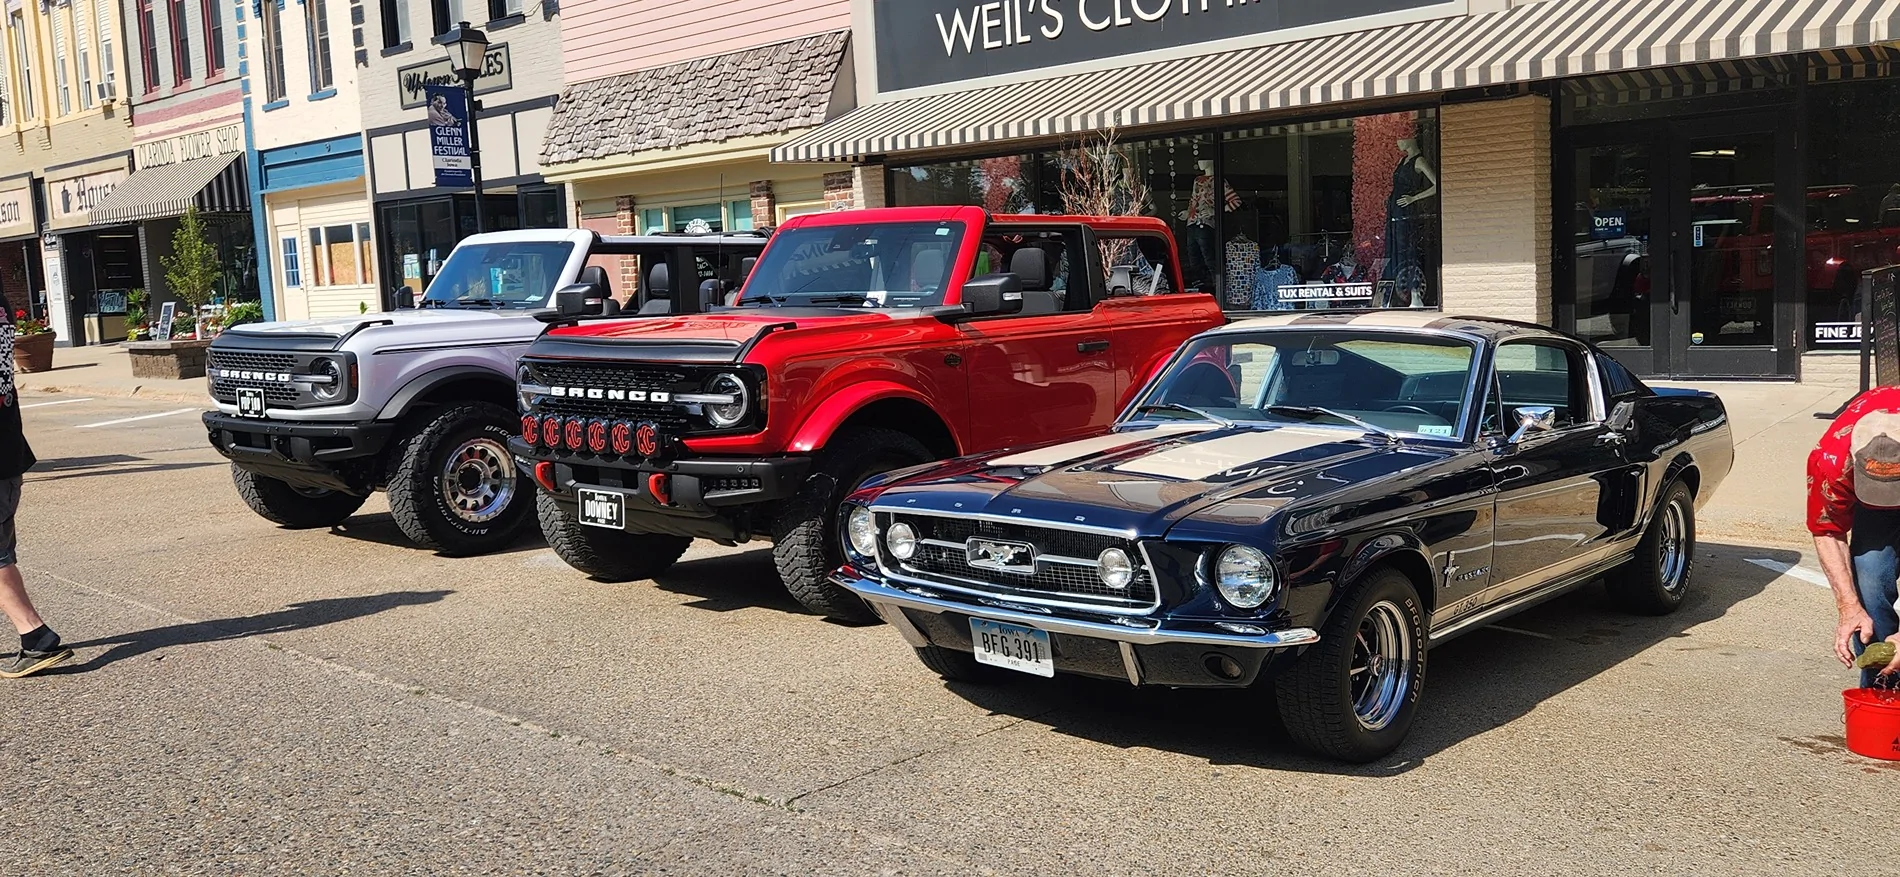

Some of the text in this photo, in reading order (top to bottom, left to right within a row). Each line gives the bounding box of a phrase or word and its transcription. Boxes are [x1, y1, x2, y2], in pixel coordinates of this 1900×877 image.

[935, 0, 1063, 57] WEIL'S
[435, 126, 463, 136] GLENN
[436, 136, 464, 146] MILLER
[139, 126, 239, 169] CLARINDA FLOWER SHOP
[434, 146, 468, 155] FESTIVAL
[0, 200, 20, 223] son
[1278, 286, 1372, 298] TUX RENTAL & SUITS
[1815, 327, 1848, 338] FINE
[220, 370, 291, 381] BRONCO
[551, 386, 670, 402] BRONCO
[521, 416, 538, 444] KC
[543, 418, 560, 446] KC
[565, 420, 582, 449] KC
[588, 421, 605, 451] KC
[611, 423, 630, 453] KC
[636, 425, 656, 456] KC
[585, 499, 618, 520] DOWNEY
[981, 632, 1041, 664] BFG 391
[1404, 598, 1425, 703] BFGoodrich
